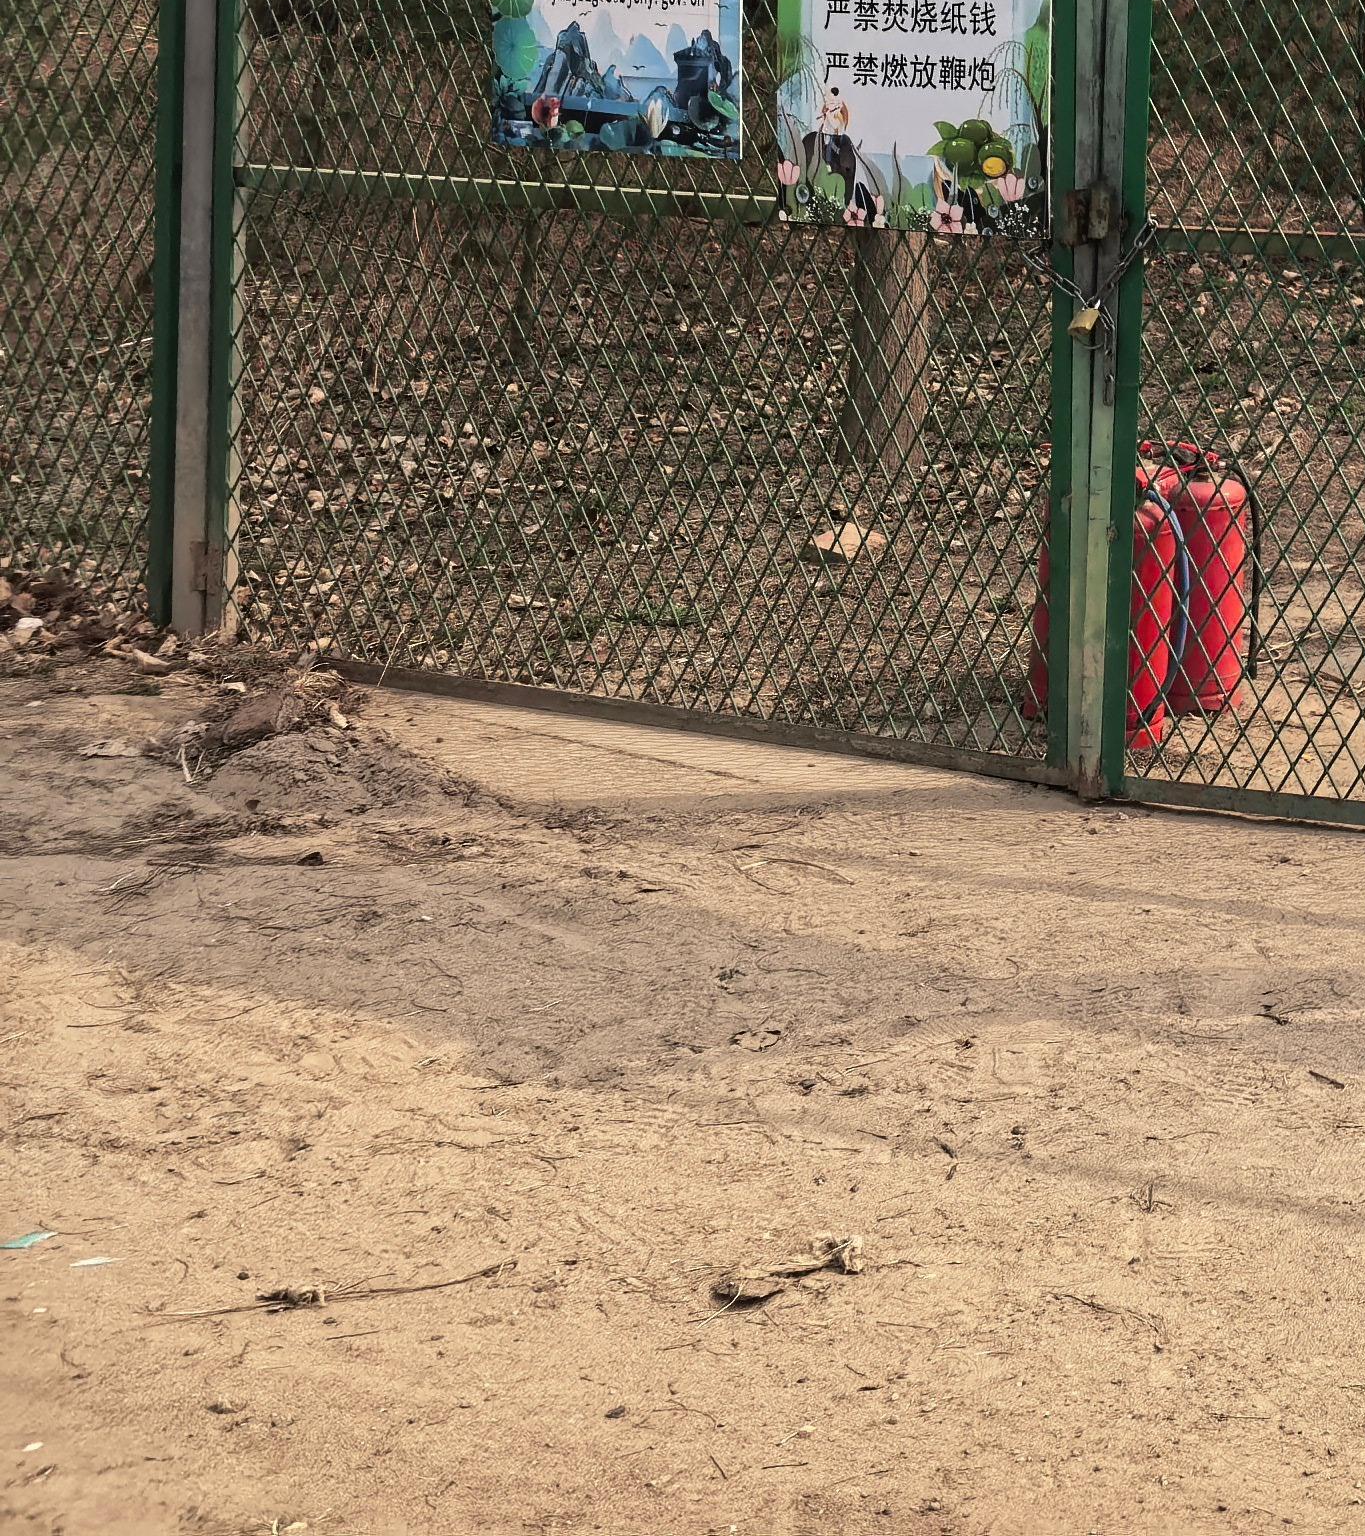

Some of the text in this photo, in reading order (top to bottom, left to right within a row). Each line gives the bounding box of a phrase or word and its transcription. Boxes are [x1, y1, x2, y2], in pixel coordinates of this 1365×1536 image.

[823, 51, 996, 93] 严禁燃放鞭炮
